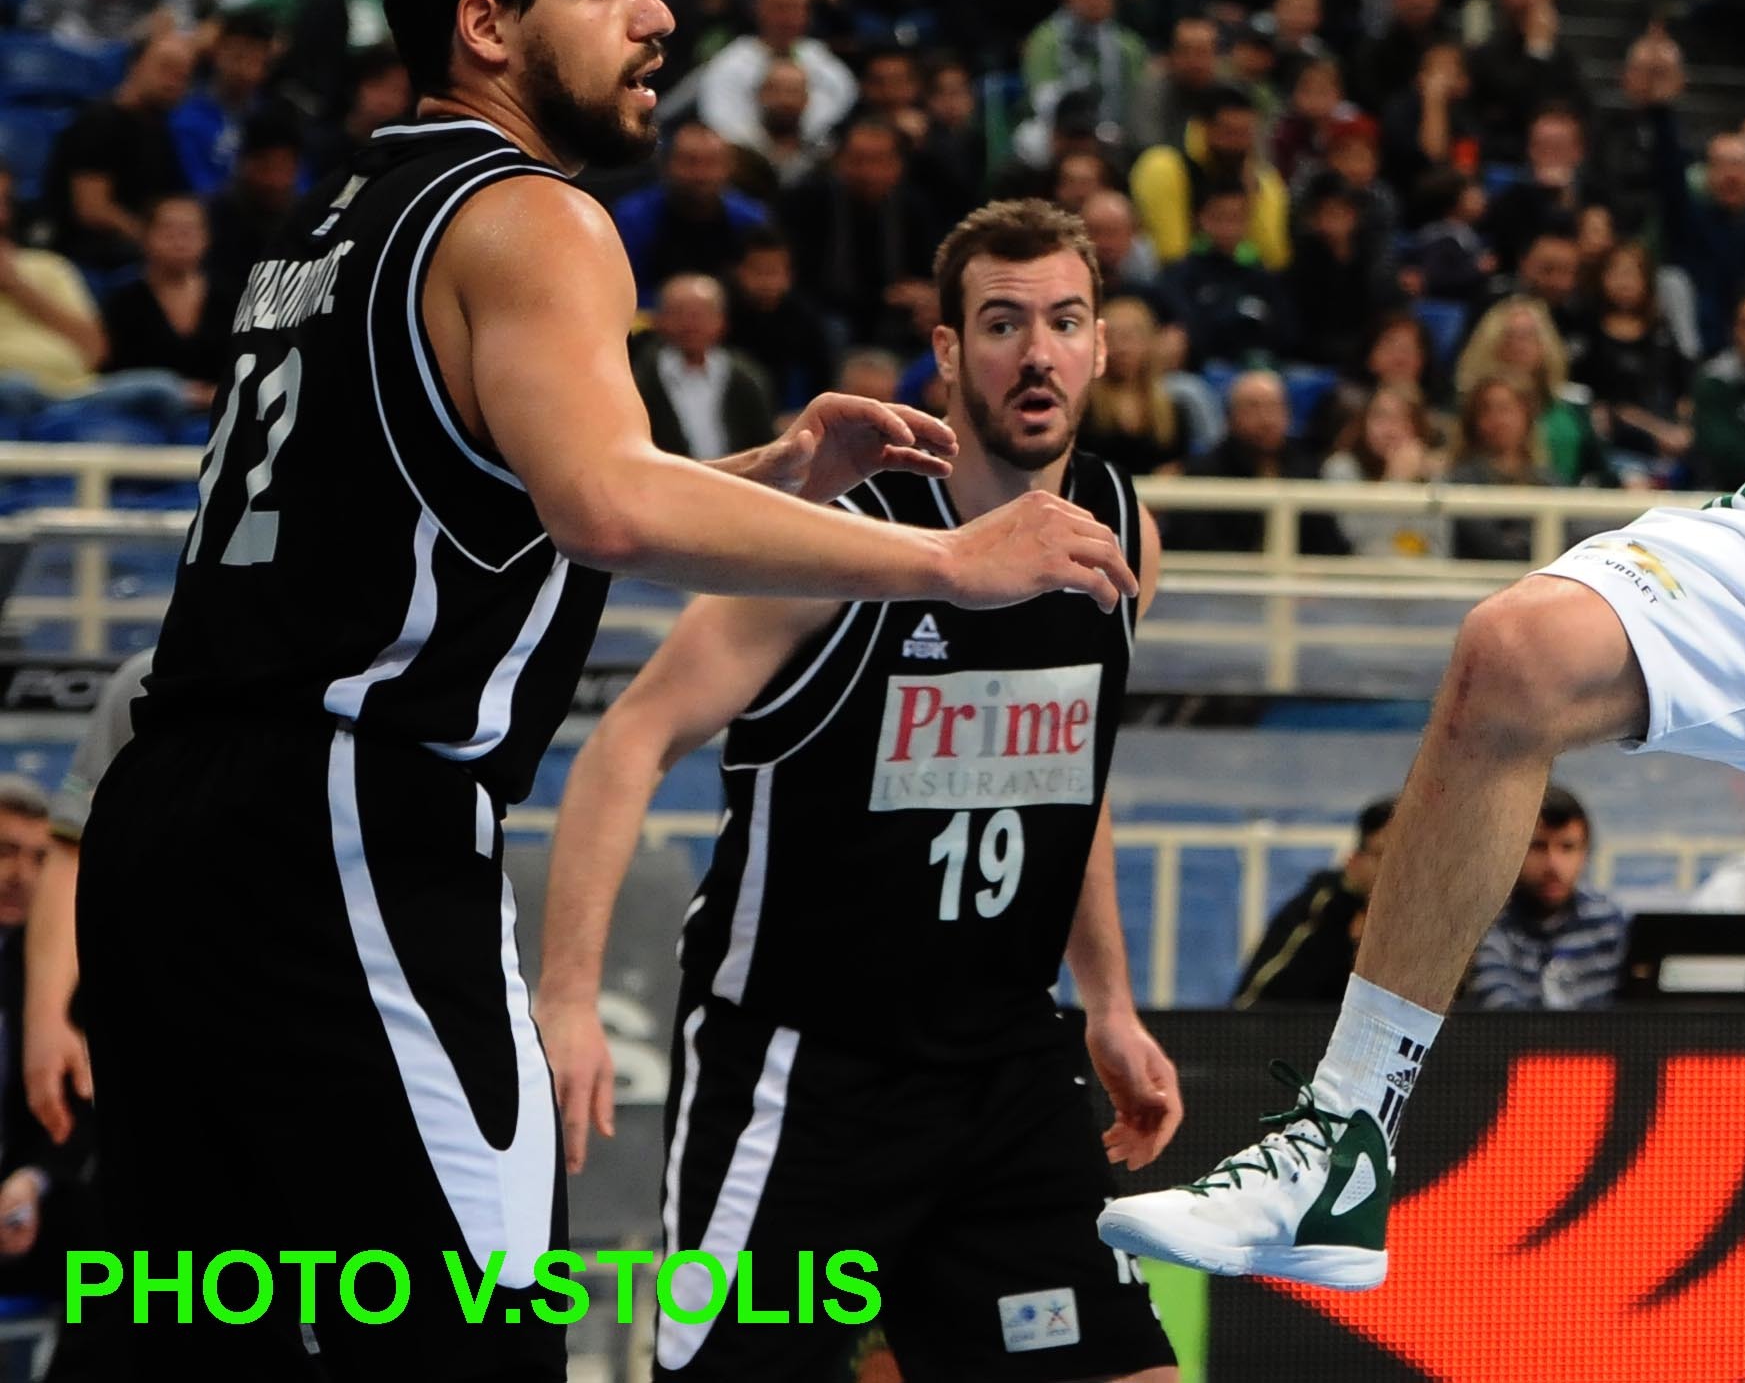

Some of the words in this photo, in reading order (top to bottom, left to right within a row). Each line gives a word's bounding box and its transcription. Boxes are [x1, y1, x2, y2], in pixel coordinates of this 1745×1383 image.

[885, 679, 1090, 762] Prime
[880, 768, 1087, 801] INSURANCE
[929, 808, 1025, 921] 19
